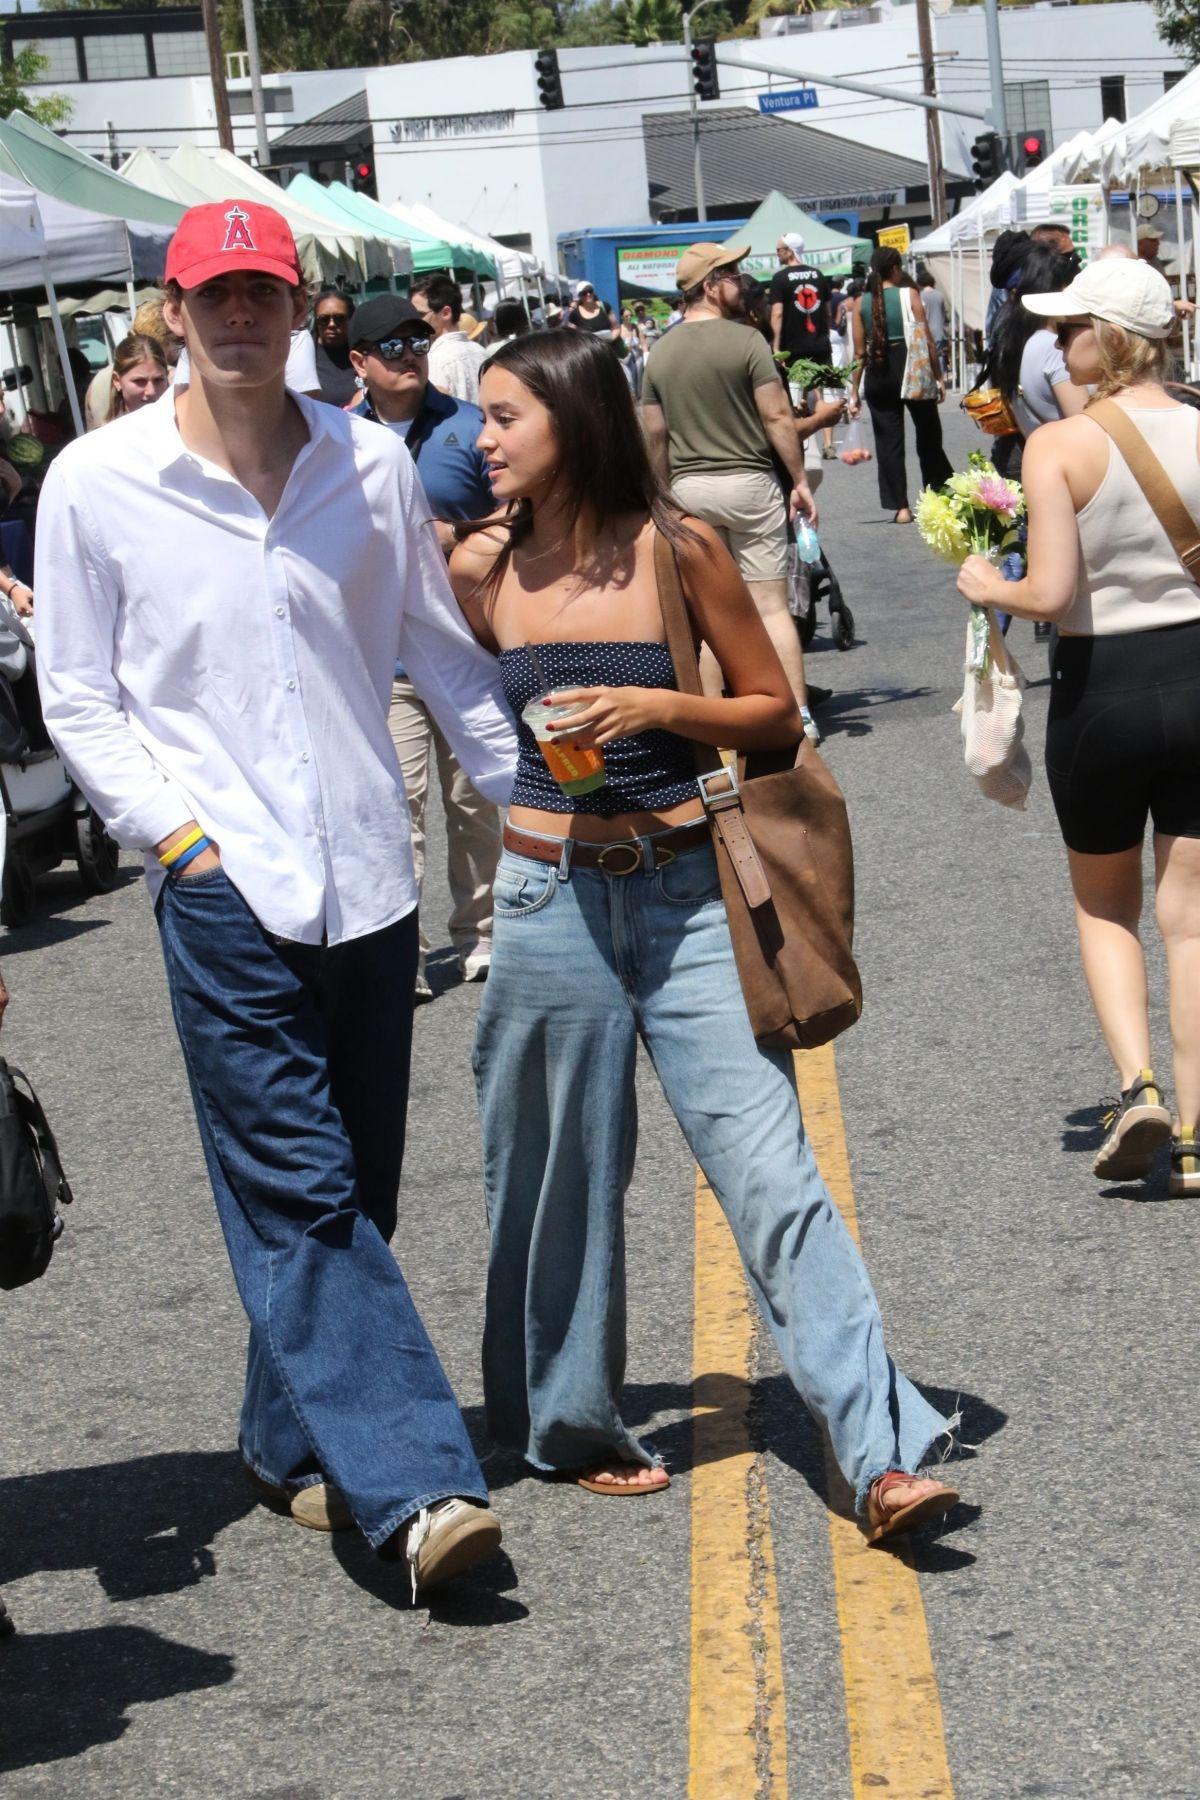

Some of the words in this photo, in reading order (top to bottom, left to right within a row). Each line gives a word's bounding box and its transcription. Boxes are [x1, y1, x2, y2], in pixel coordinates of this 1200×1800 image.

[762, 95, 801, 109] Ventura
[803, 92, 815, 105] Pl
[222, 206, 257, 251] A
[1072, 197, 1088, 270] ORGA
[623, 249, 679, 259] DIAMOND
[787, 270, 818, 281] SOTO'S
